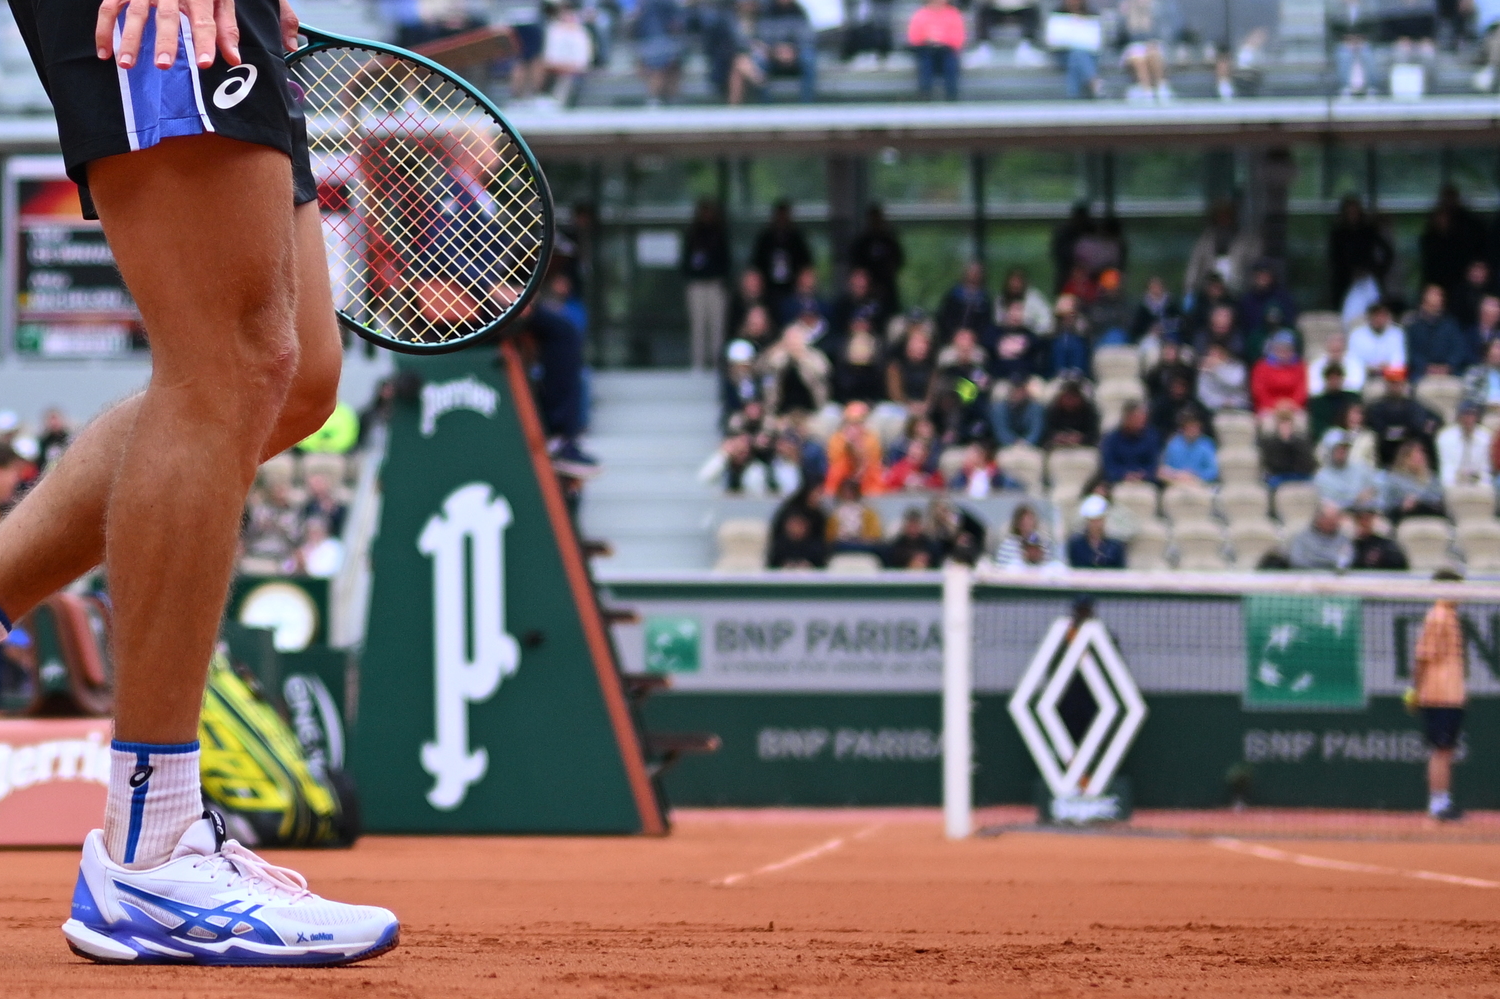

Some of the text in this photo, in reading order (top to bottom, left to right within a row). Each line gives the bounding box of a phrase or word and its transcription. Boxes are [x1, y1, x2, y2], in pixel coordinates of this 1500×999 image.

[714, 619, 944, 652] BNP PARIBA
[758, 730, 943, 760] BNP PARIB
[1244, 731, 1315, 762] BNP
